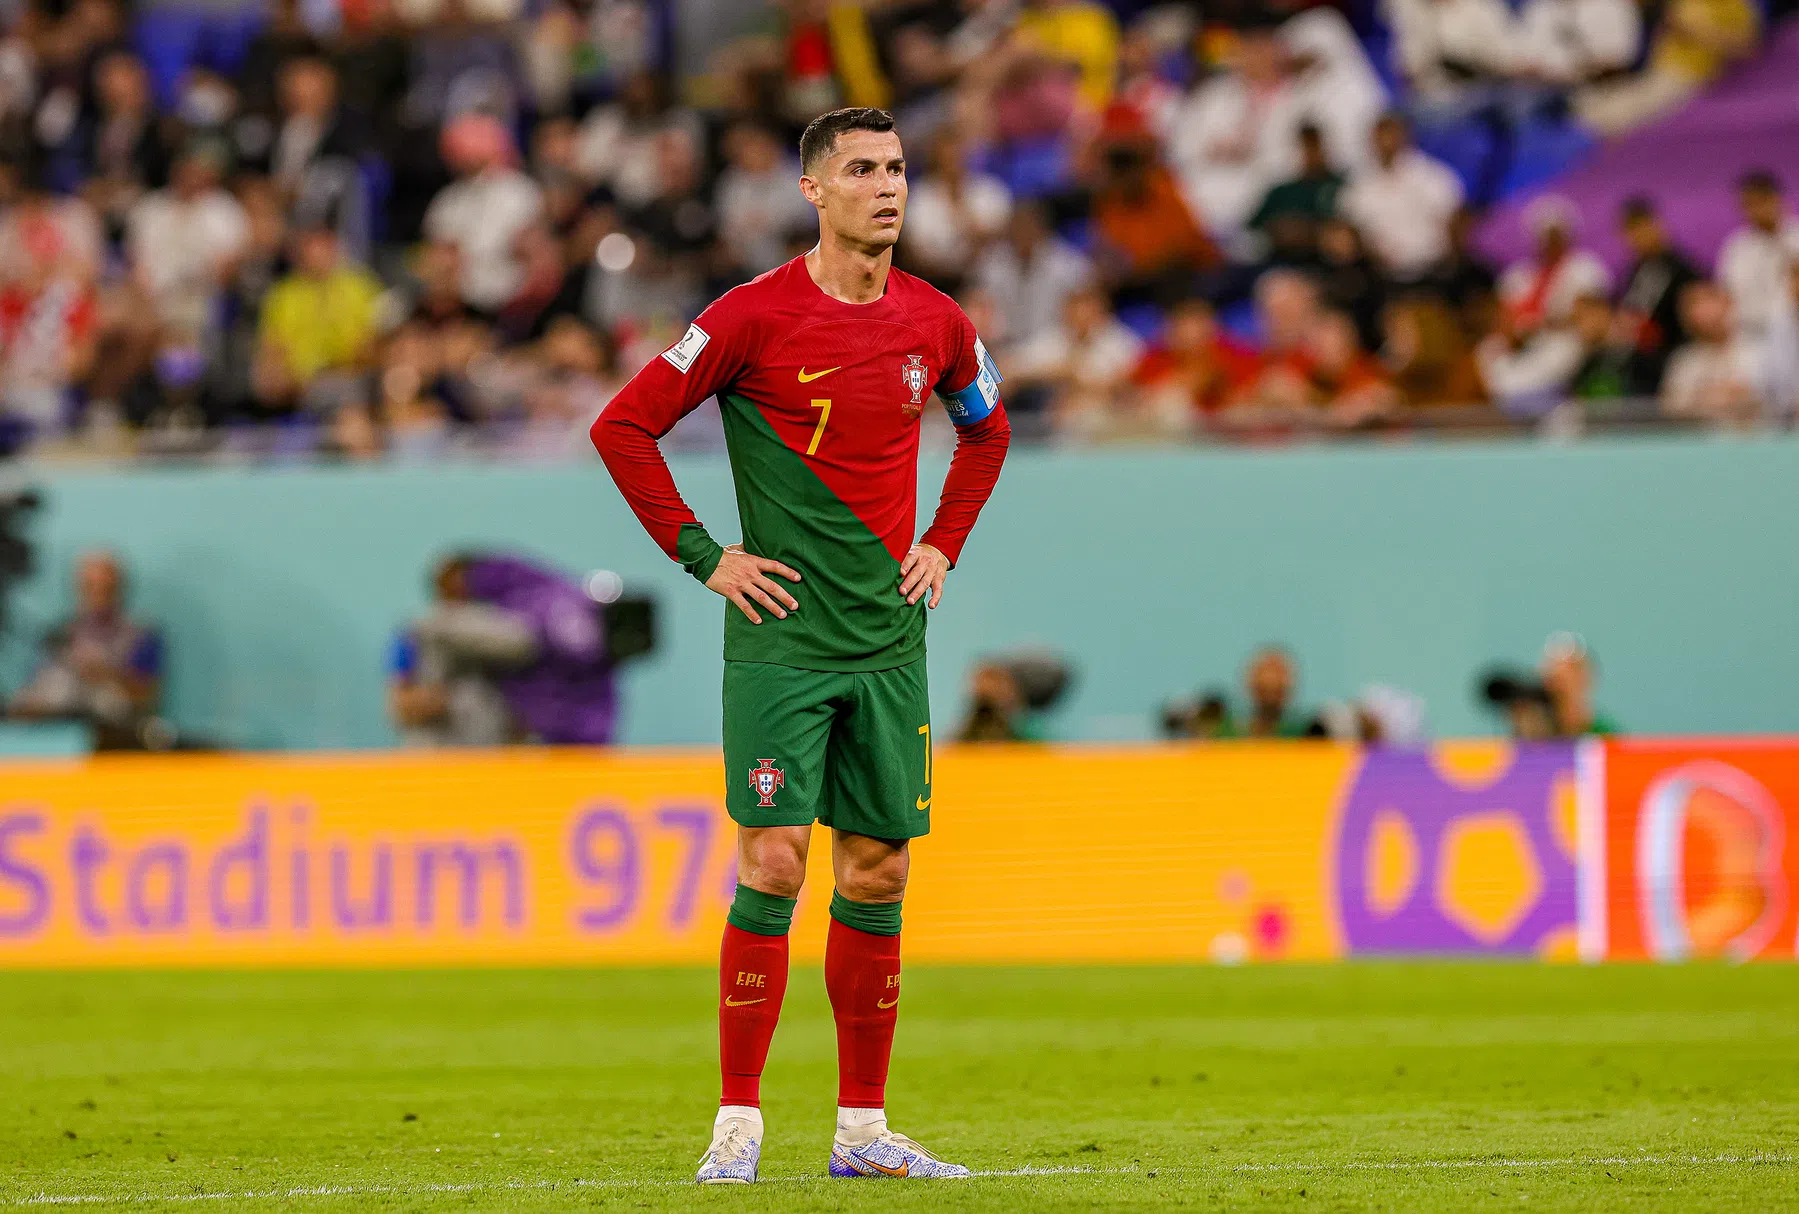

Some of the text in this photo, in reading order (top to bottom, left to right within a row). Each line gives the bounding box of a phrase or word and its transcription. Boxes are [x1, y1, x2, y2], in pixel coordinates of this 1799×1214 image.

[806, 398, 832, 456] 7
[0, 801, 738, 934] Stadium 97
